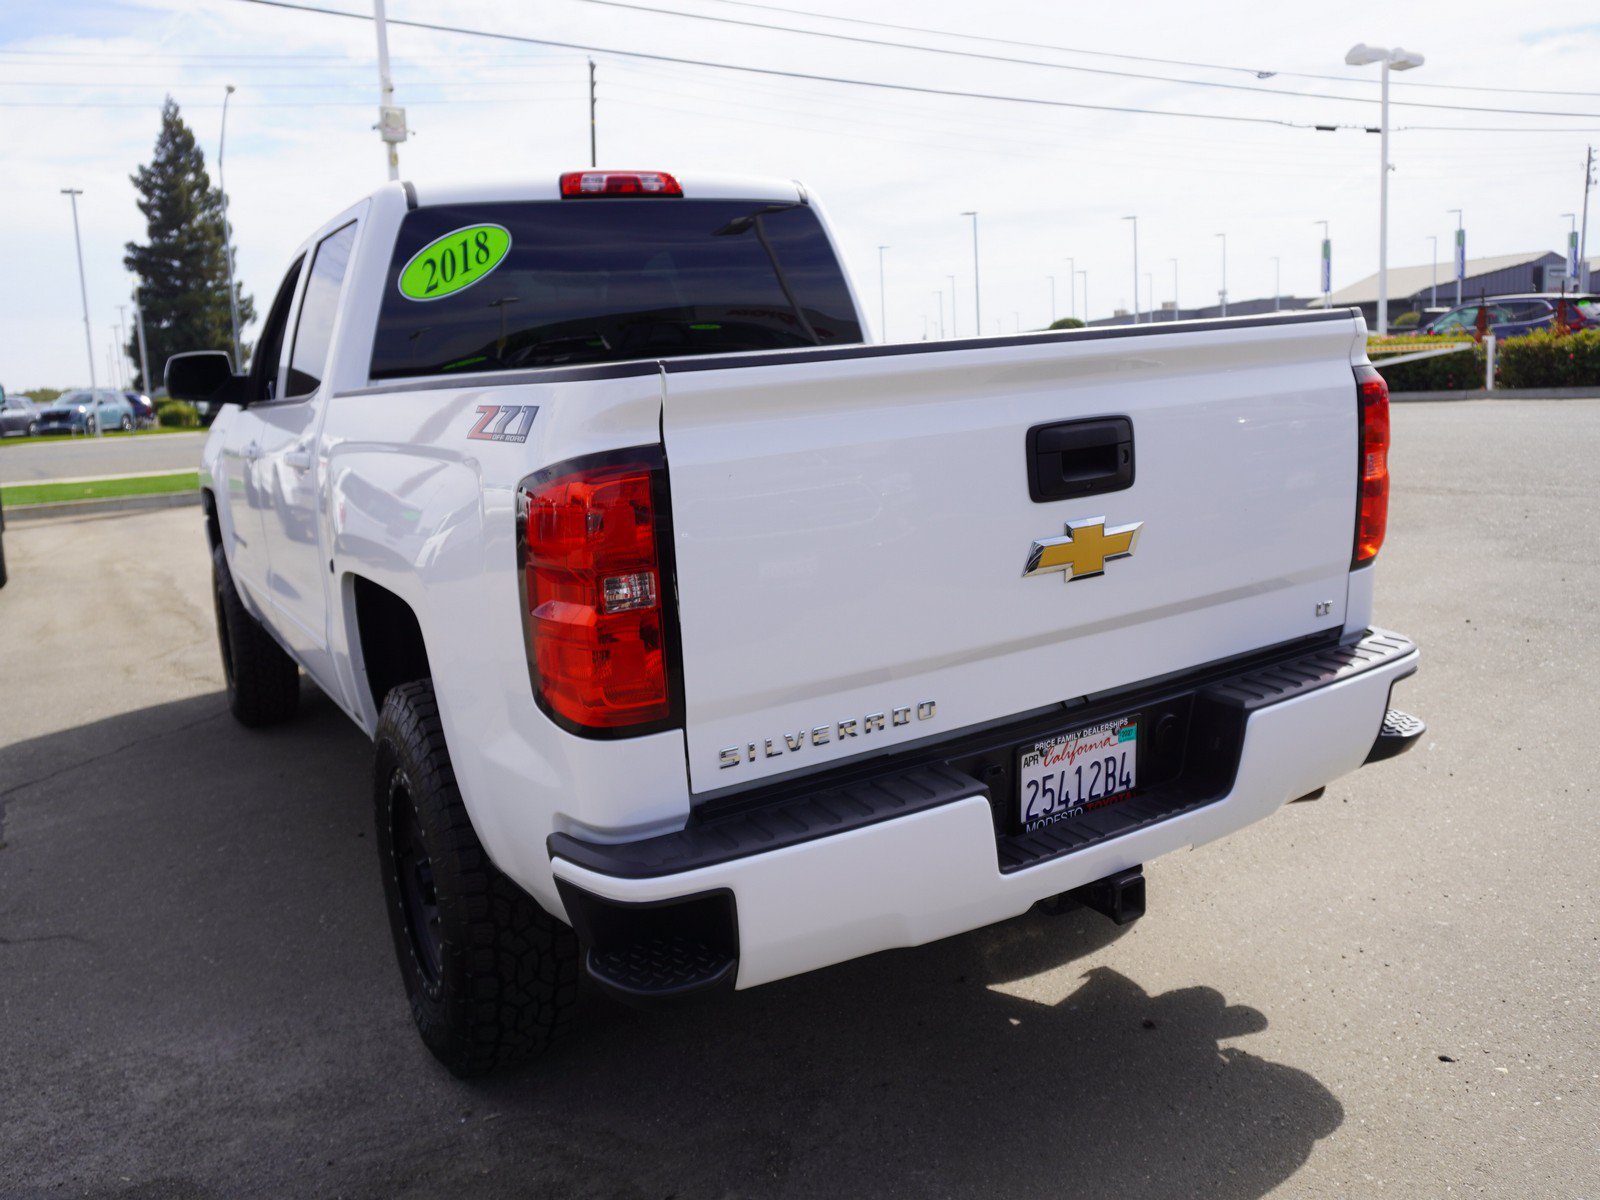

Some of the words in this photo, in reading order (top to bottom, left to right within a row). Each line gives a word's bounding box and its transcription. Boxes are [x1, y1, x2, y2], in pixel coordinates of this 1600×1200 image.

[422, 230, 490, 294] 2018
[467, 405, 540, 442] Z71
[719, 700, 937, 769] SILVERADO
[1034, 738, 1056, 751] PRICE
[1057, 731, 1082, 744] FAMILY
[1082, 718, 1129, 737] DEALERSHIPS
[1043, 737, 1119, 768] California
[1023, 754, 1039, 768] APR
[1025, 751, 1132, 822] 25412B4
